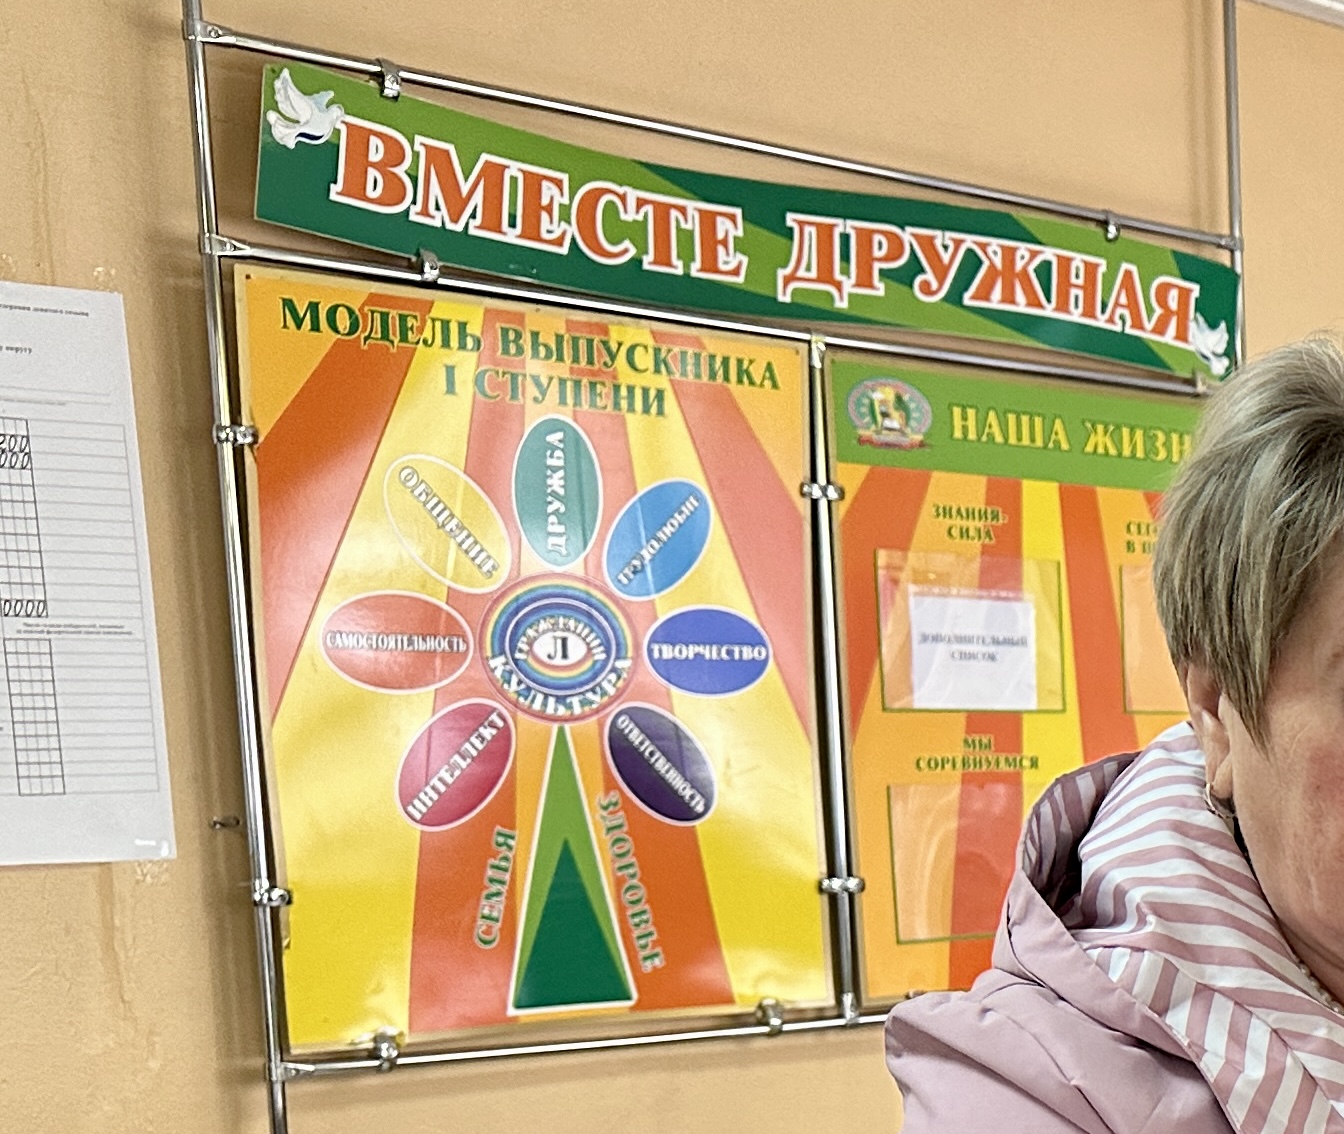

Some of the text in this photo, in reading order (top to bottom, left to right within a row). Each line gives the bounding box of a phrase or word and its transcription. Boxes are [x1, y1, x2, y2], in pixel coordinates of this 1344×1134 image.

[330, 116, 1199, 348] ВМЕСТЕ ДРУЖНАЯ
[279, 298, 780, 390] МОДЕЛЬ ВЫПУСКНИКА
[474, 368, 666, 417] СТУПЕНИ
[951, 405, 1191, 463] НАША ЖИЗН
[399, 466, 501, 579] ОБЩЕНИЕ
[547, 430, 566, 556] ДРУЖБА
[947, 525, 993, 541] СИЛА
[325, 631, 467, 654] САМОСТОЯТЕЛЬНОСТЬ
[547, 636, 569, 660] Л
[651, 643, 767, 662] ТВОРЧЕСТВО
[488, 655, 634, 716] КУЛЬТУРА
[406, 711, 505, 821] ИНТЕЛЛЕКТ
[616, 713, 707, 814] ОТВЕТСТВЕННОСТЬ
[915, 755, 1039, 772] СОРЕВНУЕМСЯ
[963, 737, 992, 752] МЫ
[475, 827, 518, 949] СЕМЬЯ
[596, 792, 665, 973] ЗДОРОВЬЕ
